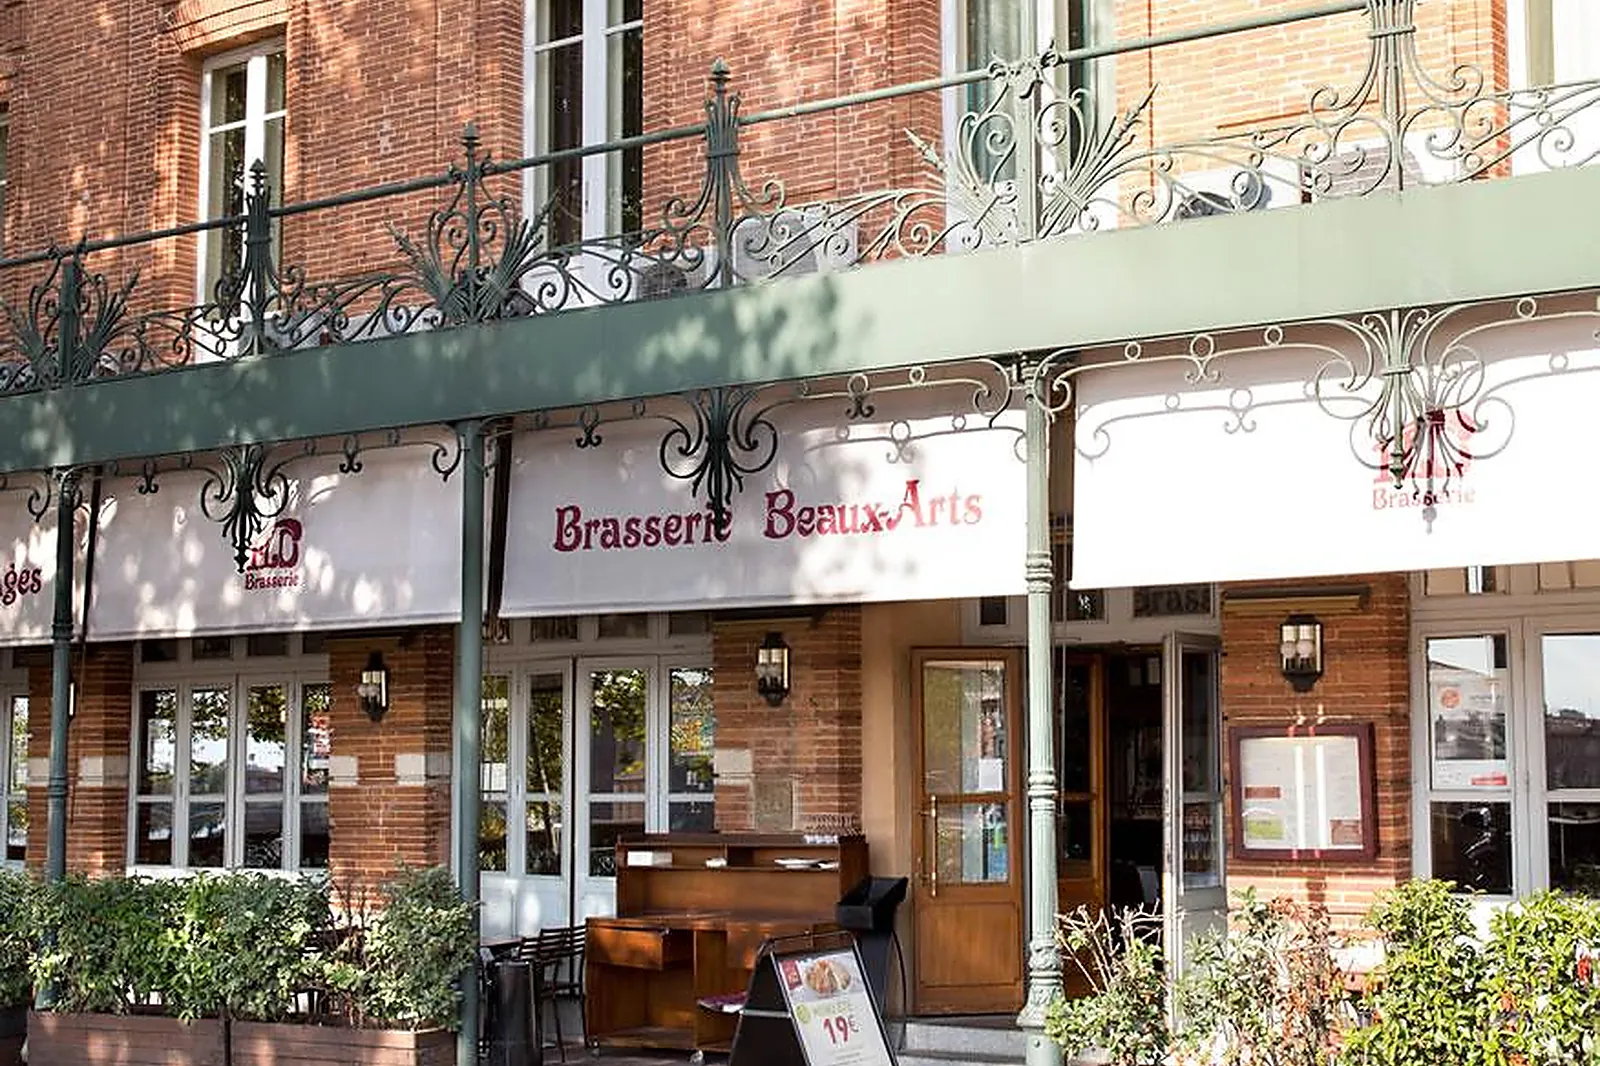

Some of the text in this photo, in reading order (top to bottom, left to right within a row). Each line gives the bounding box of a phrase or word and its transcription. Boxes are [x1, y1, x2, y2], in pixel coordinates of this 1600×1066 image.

[553, 480, 983, 551] Brasserie Beaux-Arts
[0, 563, 42, 605] ges
[246, 572, 299, 590] Brasserie
